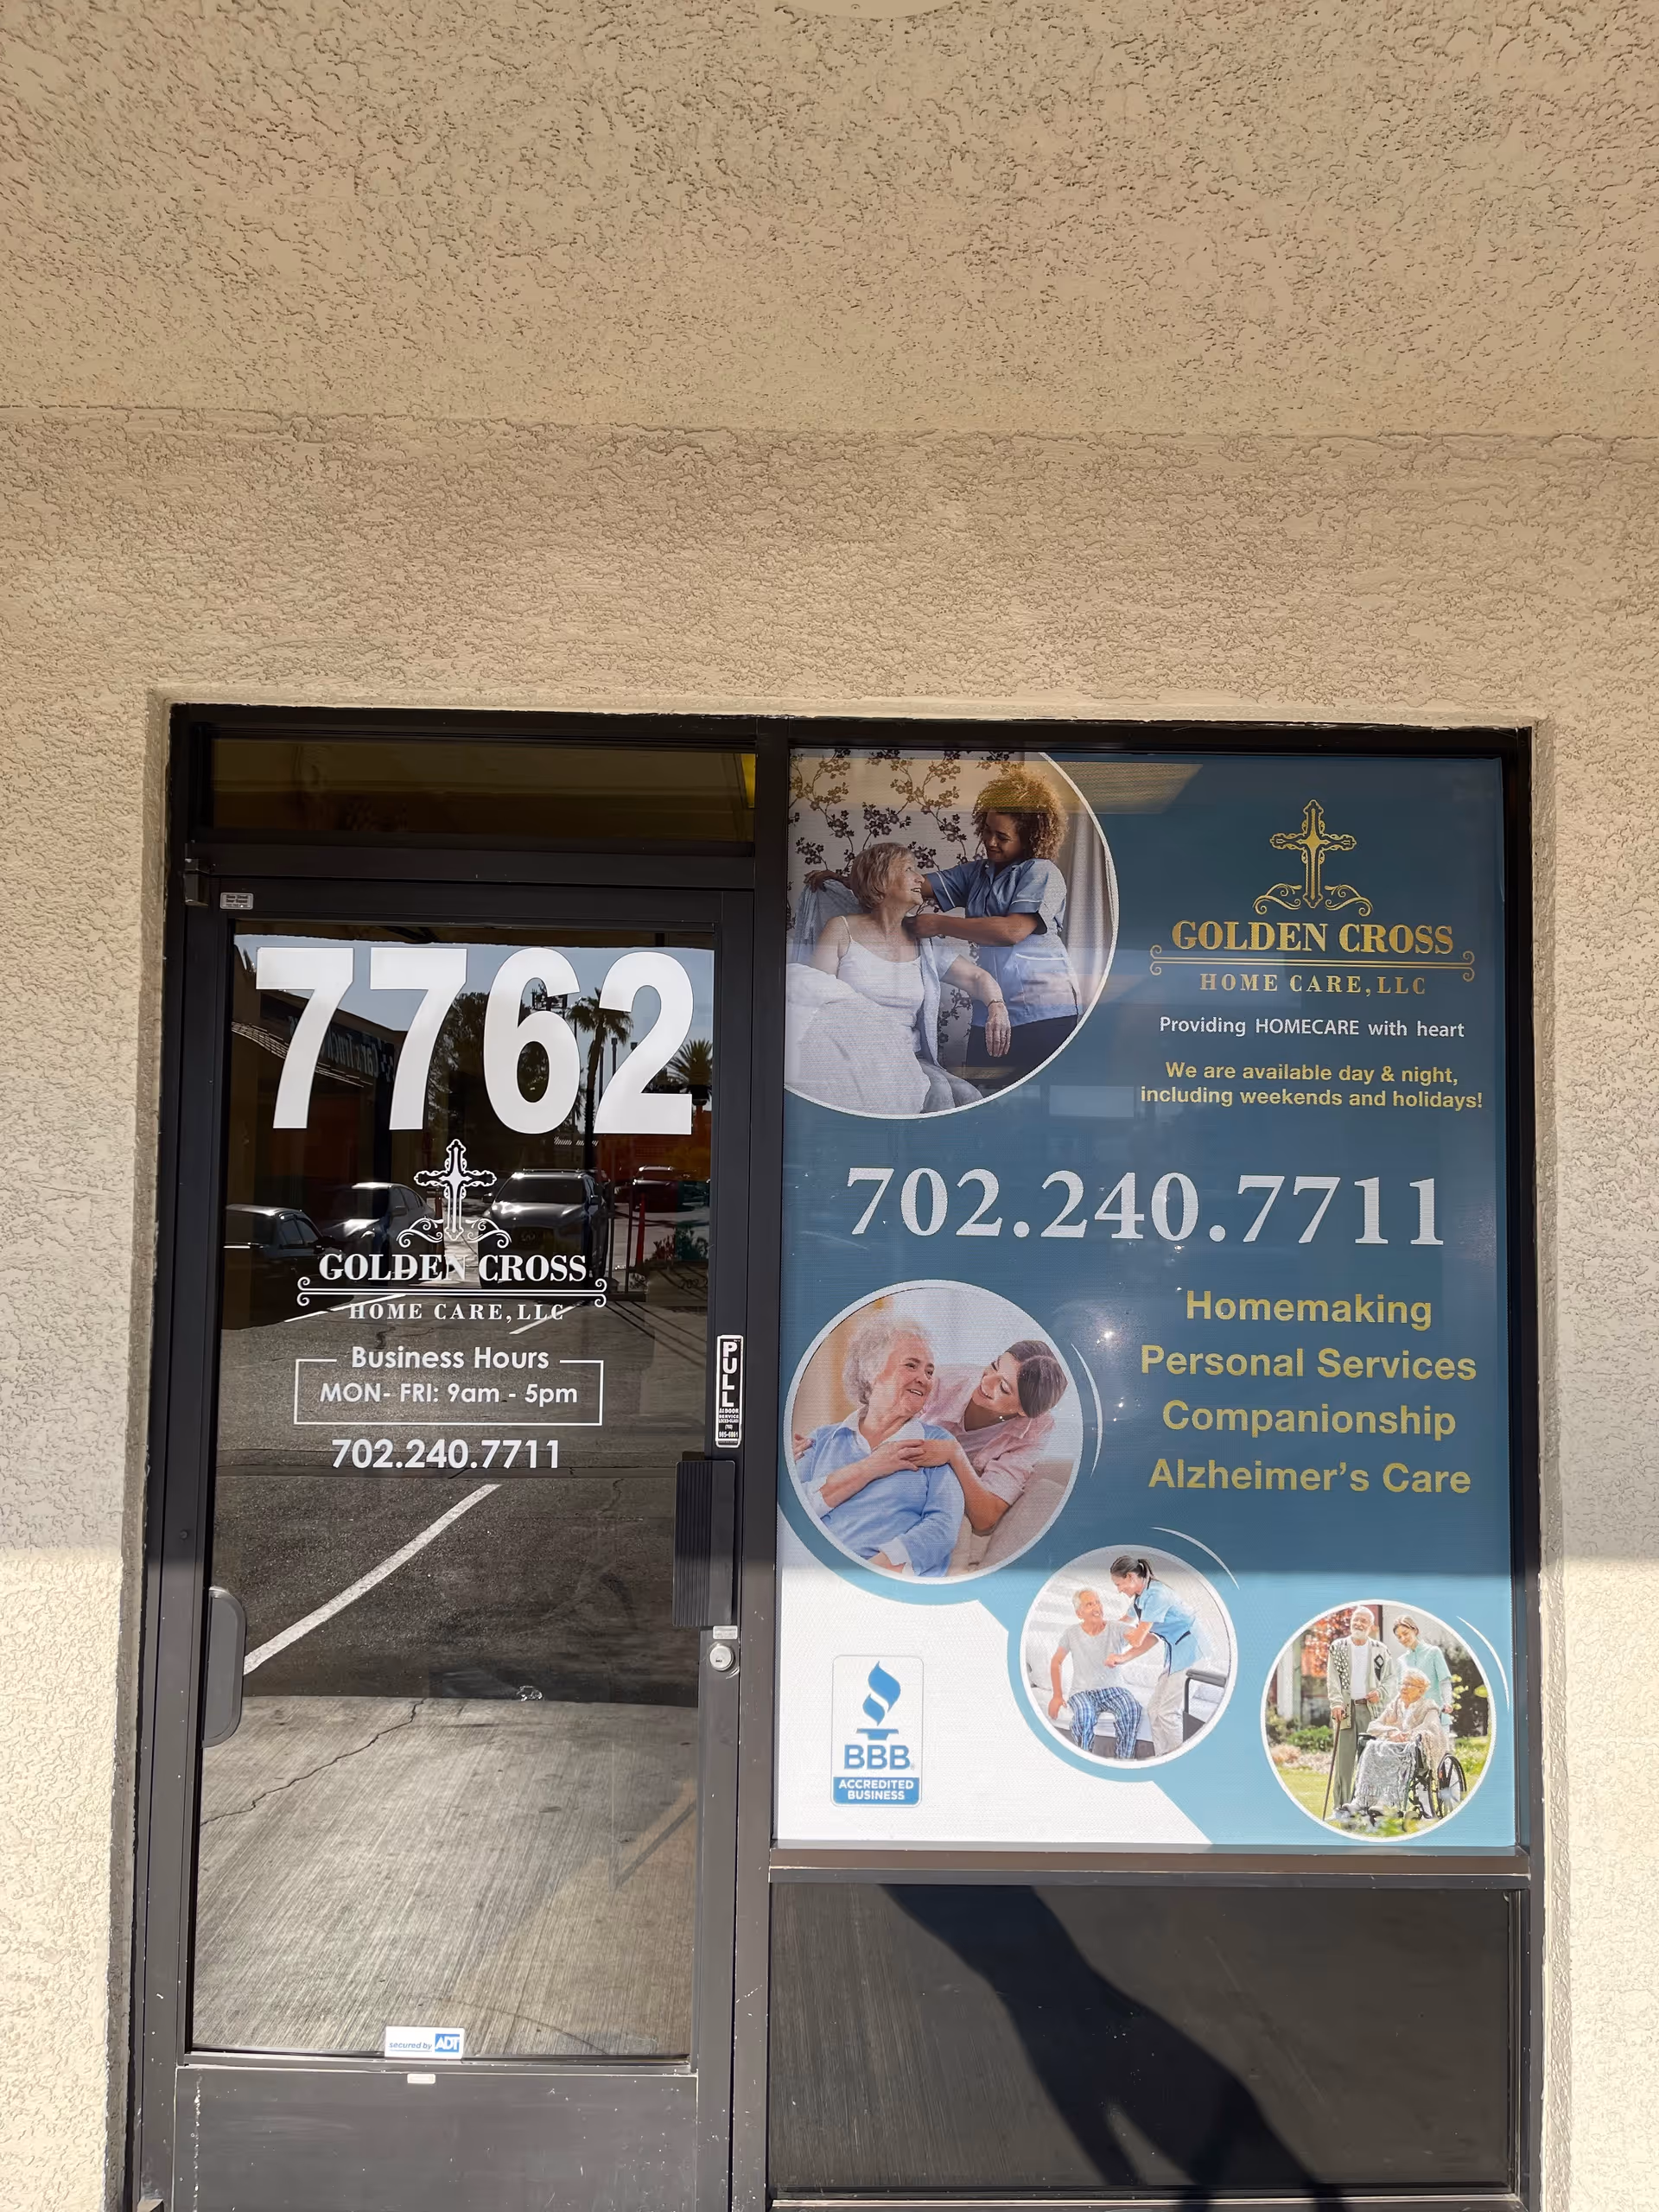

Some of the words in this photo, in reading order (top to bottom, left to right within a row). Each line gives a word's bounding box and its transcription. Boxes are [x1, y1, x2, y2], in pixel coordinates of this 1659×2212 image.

[1172, 920, 1328, 952] GOLDEN
[1338, 923, 1454, 954] CROSS
[1199, 973, 1278, 992] HOME
[1160, 1016, 1246, 1036] Providing
[1255, 1018, 1359, 1036] HOMECARE
[1368, 1020, 1408, 1037] with
[1417, 1020, 1465, 1038] heart
[256, 947, 694, 1136] 7762
[1166, 1062, 1197, 1078] We
[1204, 1067, 1236, 1079] are
[1243, 1065, 1332, 1081] available
[1338, 1065, 1375, 1085] day
[1381, 1066, 1395, 1082] &
[1402, 1067, 1459, 1086] night,
[1141, 1087, 1233, 1106] including
[1241, 1090, 1342, 1107] weekends
[1349, 1092, 1387, 1107] and
[1393, 1091, 1483, 1112] holidays!
[848, 1167, 1444, 1245] 702.240.7711
[319, 1254, 467, 1281] GOLDEN
[479, 1255, 587, 1283] CROSS
[348, 1303, 423, 1320] HOME
[1186, 1290, 1432, 1332] Homemaking
[352, 1346, 465, 1369] Business
[474, 1346, 550, 1370] Hours
[1141, 1344, 1304, 1376] Personal
[1318, 1348, 1477, 1381] Services
[721, 1341, 738, 1408] PULL
[320, 1382, 391, 1402] MON-
[400, 1383, 439, 1403] FRI:
[448, 1383, 499, 1403] 9am
[524, 1384, 578, 1408] 5pm
[1163, 1400, 1456, 1441] Companionship
[332, 1439, 559, 1469] 702.240.7711
[1383, 1462, 1471, 1494] Care
[844, 1745, 911, 1770] BBB
[838, 1779, 914, 1789] ACCREDITED
[848, 1790, 905, 1800] BUSINESS
[423, 2042, 432, 2050] by
[435, 2036, 460, 2050] ADT
